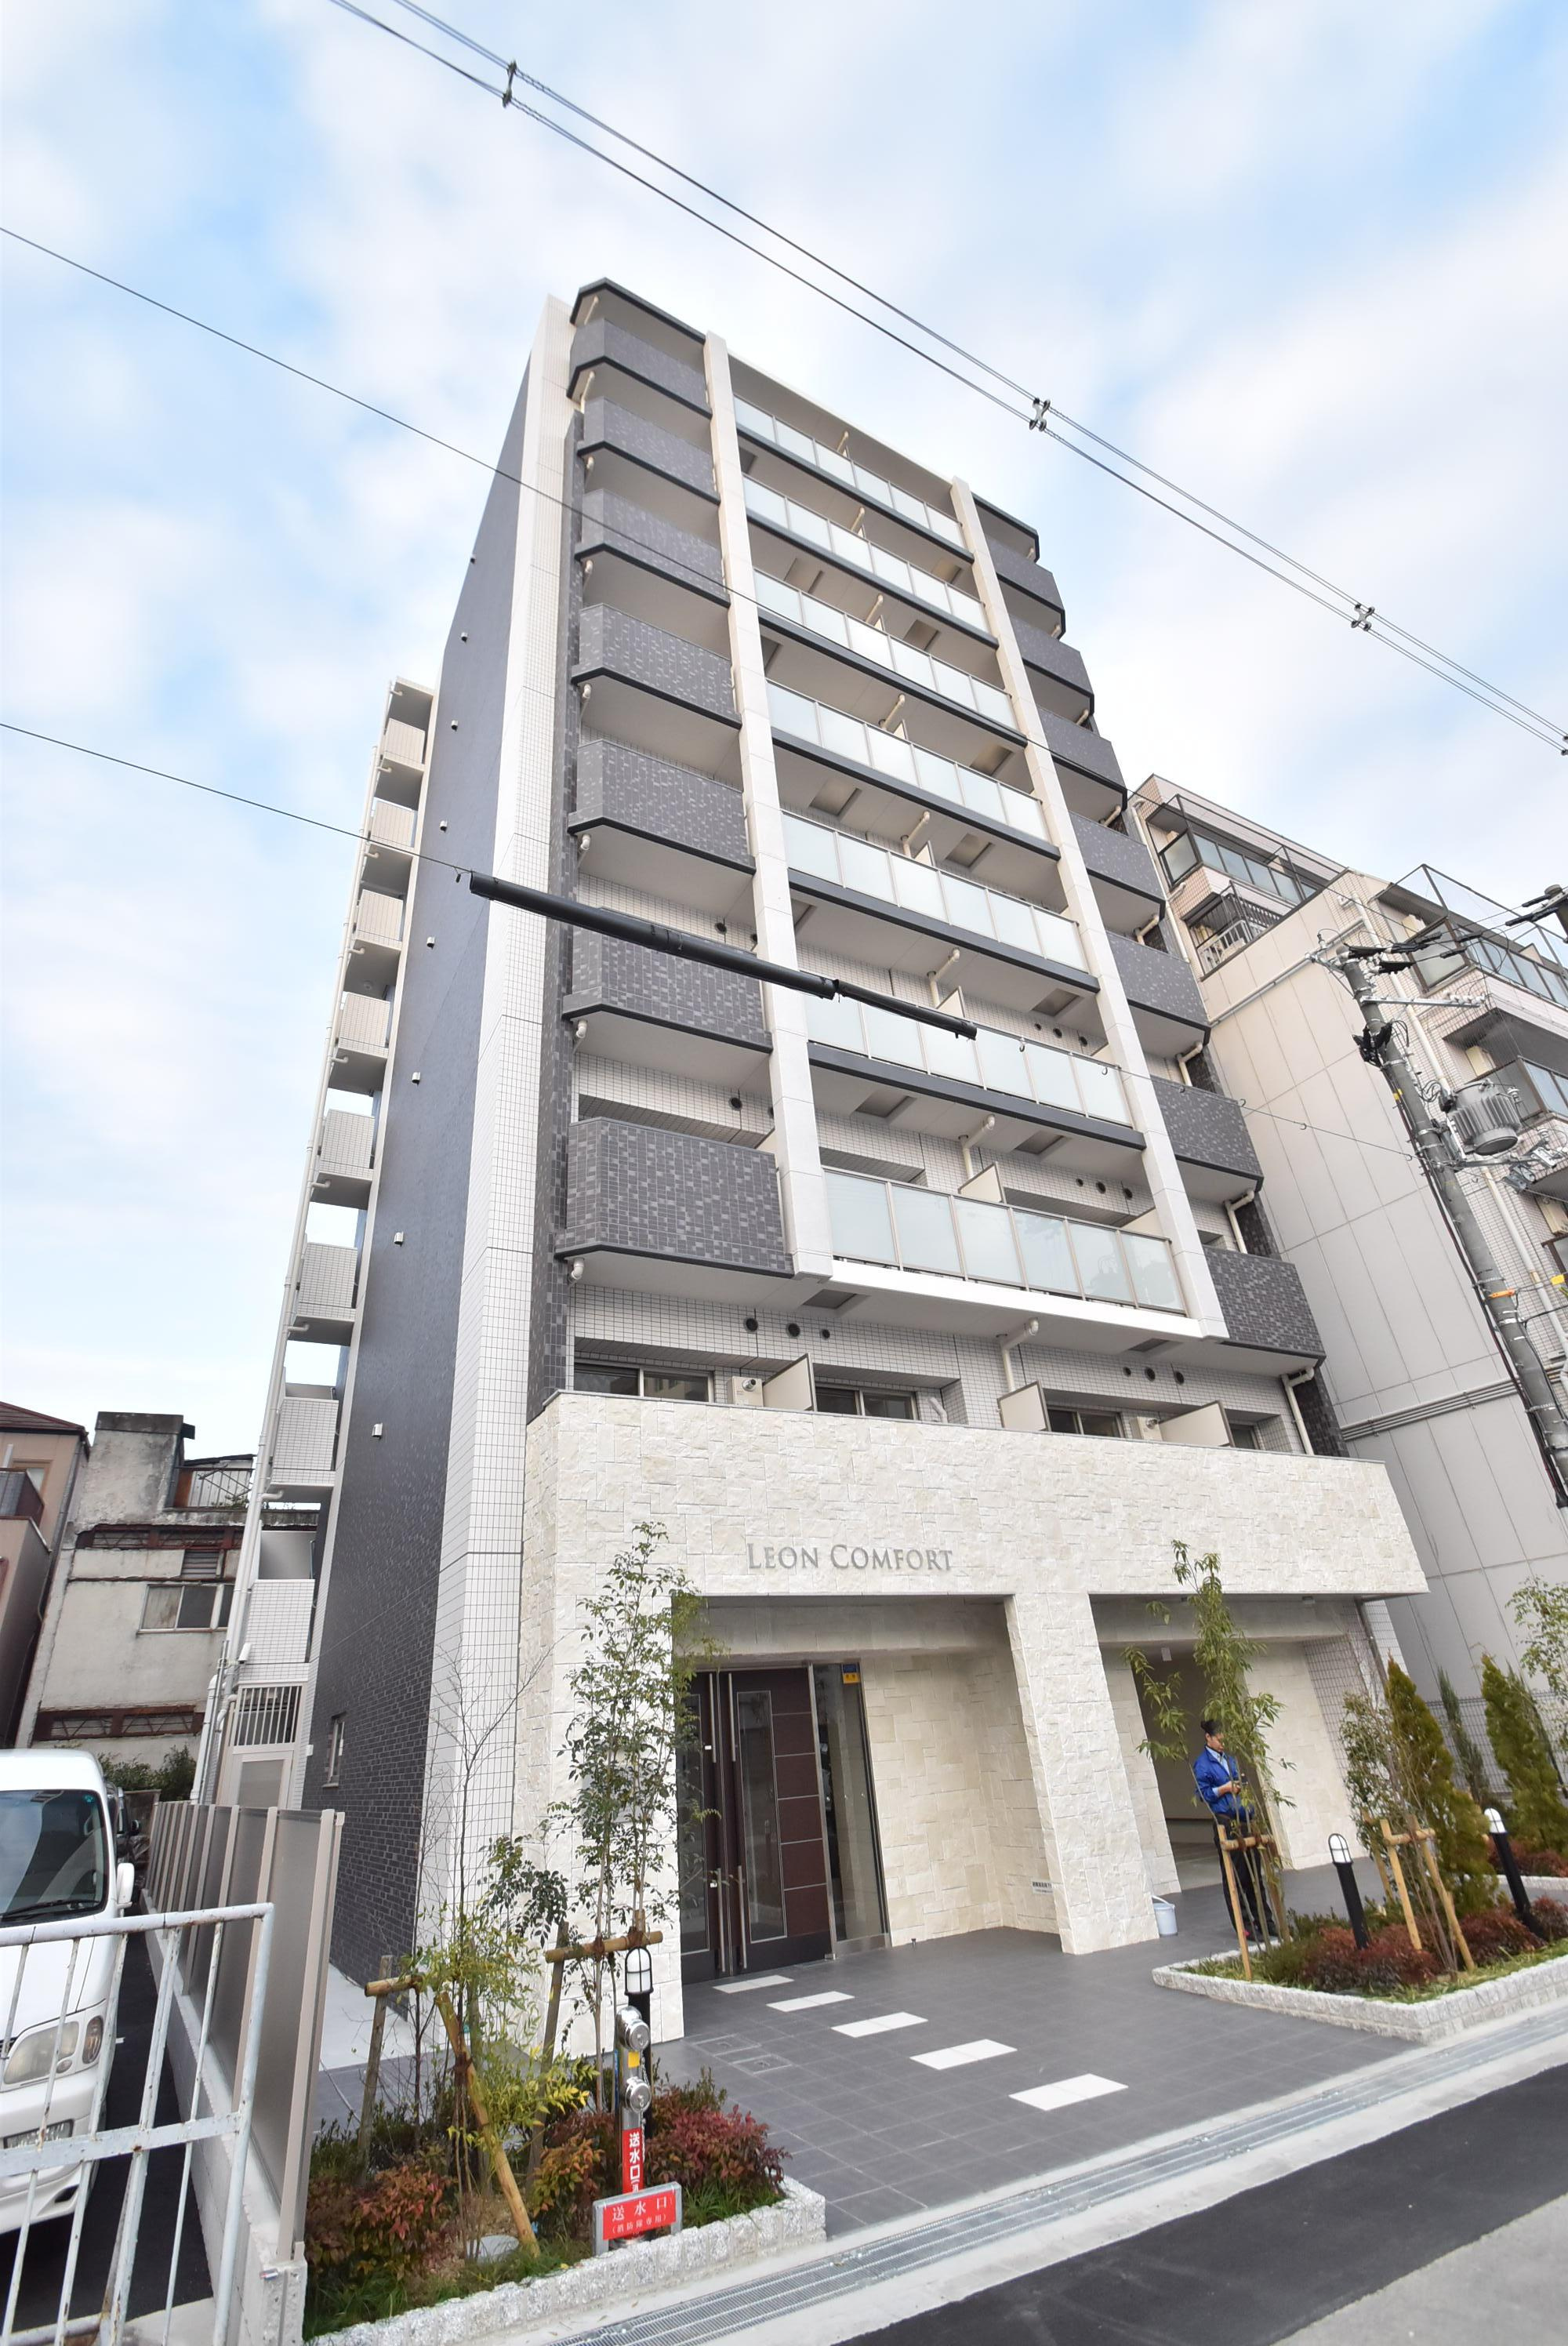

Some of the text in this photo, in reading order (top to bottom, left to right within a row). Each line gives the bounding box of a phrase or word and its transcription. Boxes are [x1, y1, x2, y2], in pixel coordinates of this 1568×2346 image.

[747, 1542, 953, 1571] LEON COMFORT
[612, 2196, 667, 2222] 送水口
